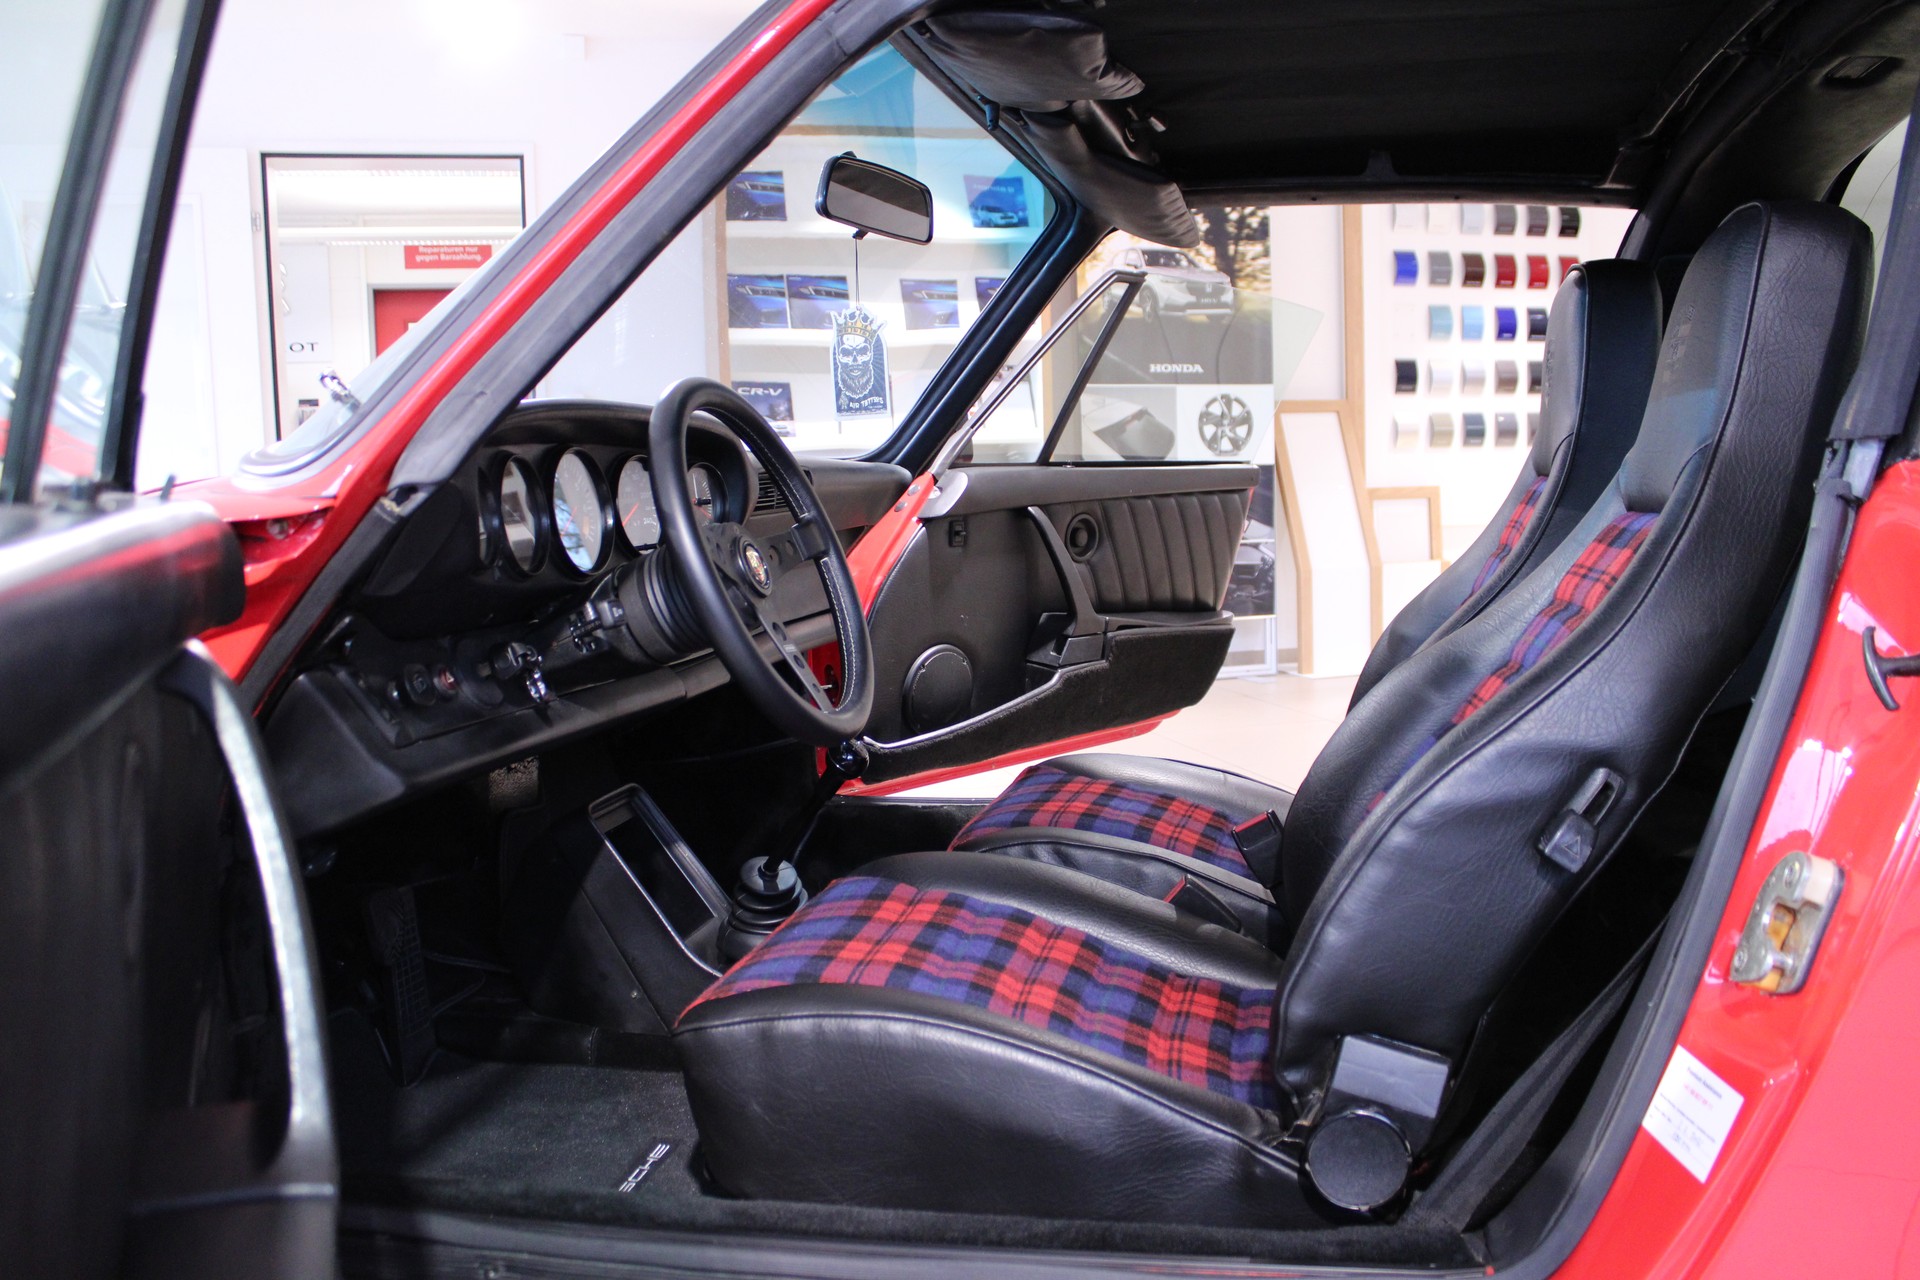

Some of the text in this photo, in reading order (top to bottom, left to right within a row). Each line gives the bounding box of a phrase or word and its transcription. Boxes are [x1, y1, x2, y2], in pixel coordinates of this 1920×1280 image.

[418, 246, 464, 254] Reparaturen
[415, 254, 439, 262] gegen
[1150, 364, 1204, 373] HONDA
[737, 387, 783, 396] CR-V
[849, 401, 860, 409] AIR
